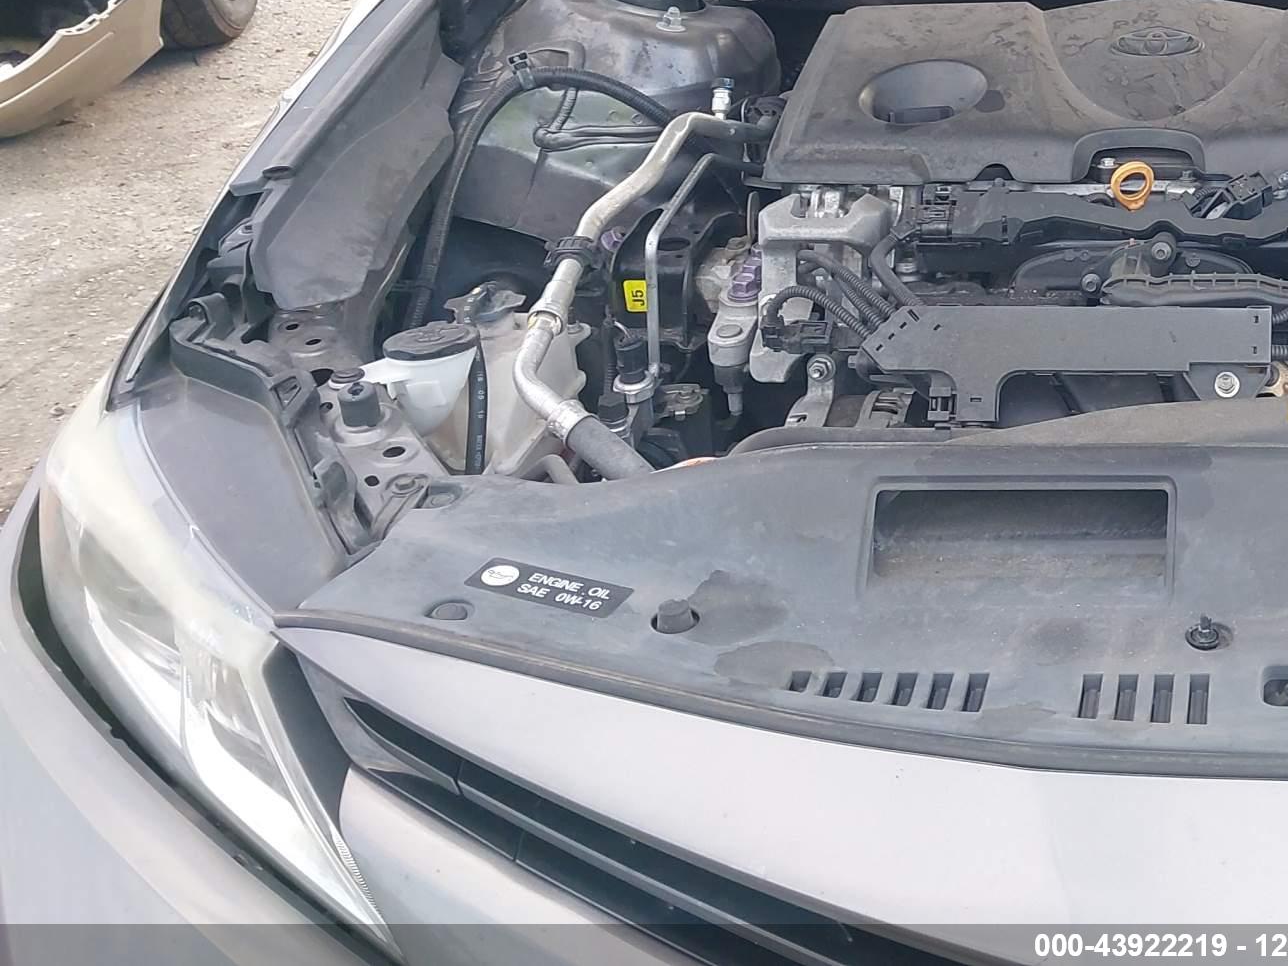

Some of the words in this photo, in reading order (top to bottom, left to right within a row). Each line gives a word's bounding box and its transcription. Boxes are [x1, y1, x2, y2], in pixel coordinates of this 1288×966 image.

[631, 289, 645, 307] J5
[516, 583, 550, 598] SAE
[554, 591, 603, 611] 0W-16
[527, 572, 584, 592] ENGINE
[588, 586, 611, 600] OIL
